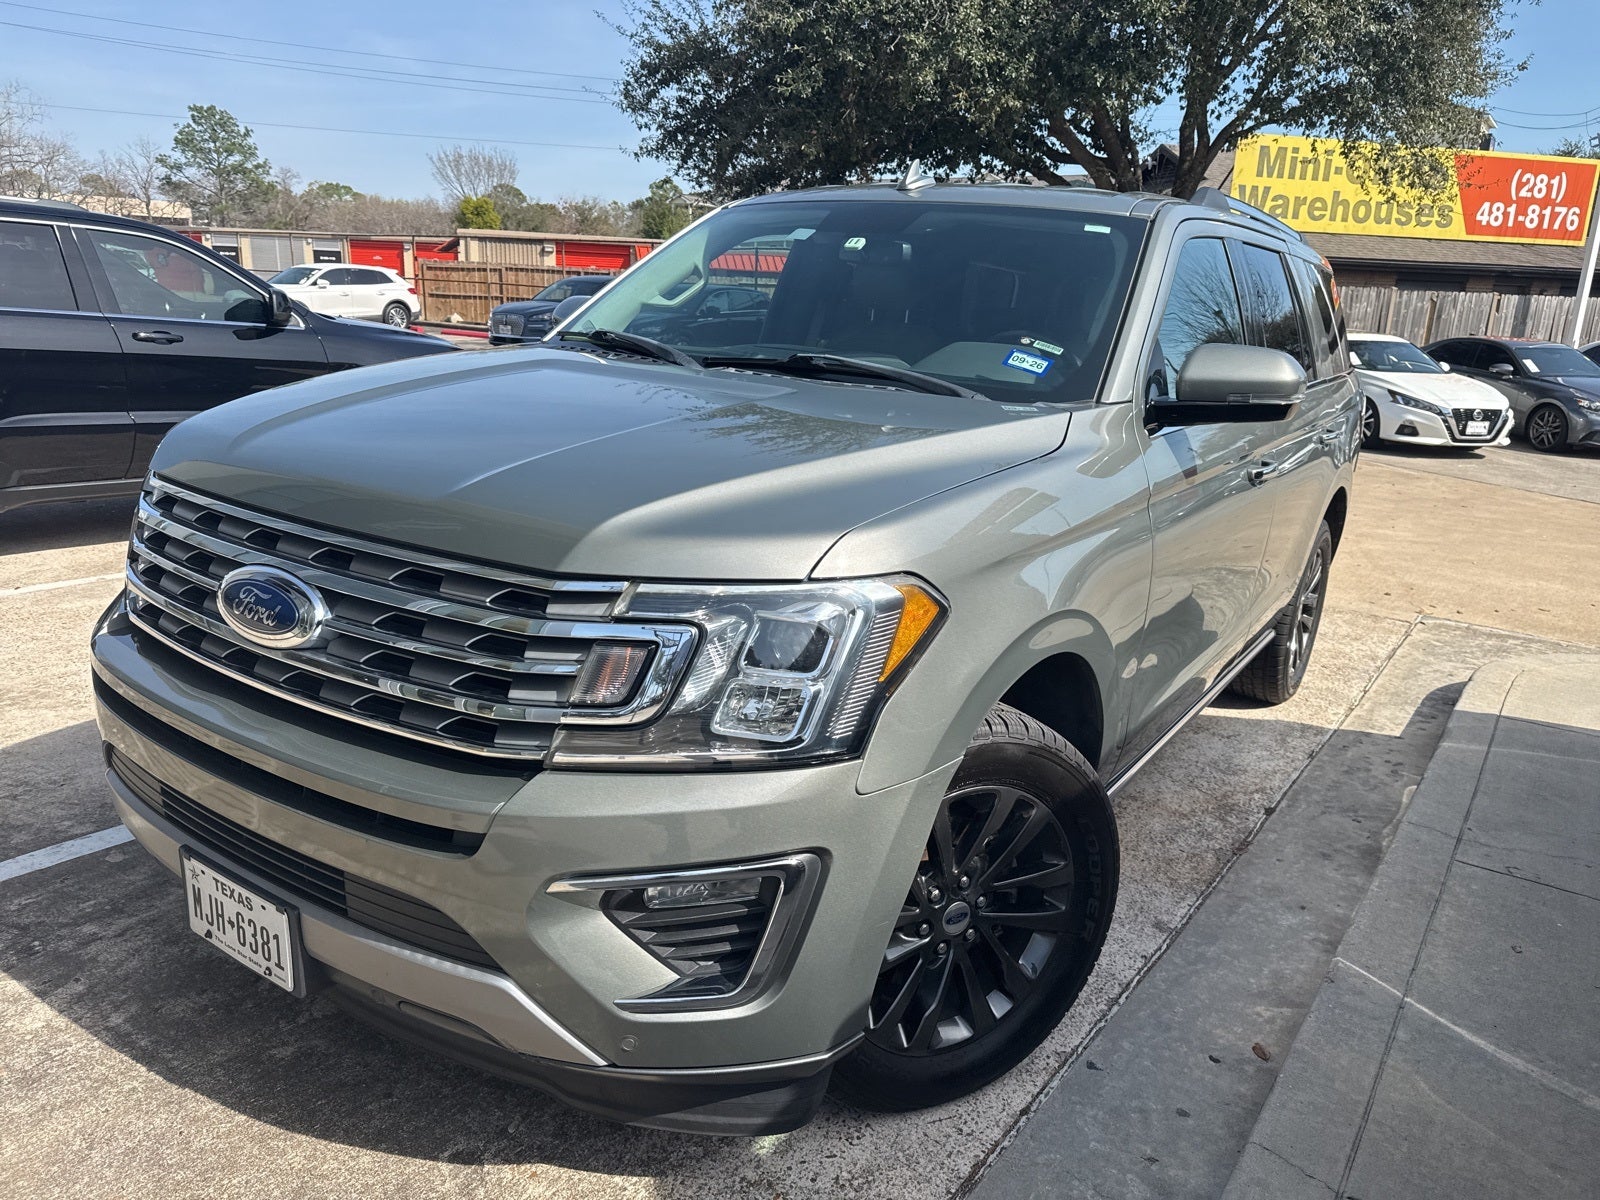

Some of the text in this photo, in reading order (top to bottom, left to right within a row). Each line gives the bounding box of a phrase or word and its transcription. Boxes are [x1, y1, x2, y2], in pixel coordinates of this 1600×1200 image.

[1511, 168, 1567, 203] (281)
[1239, 184, 1453, 229] Warehouses
[1475, 202, 1581, 232] 481-8176
[232, 586, 281, 627] Ford
[212, 877, 254, 912] TEXAS
